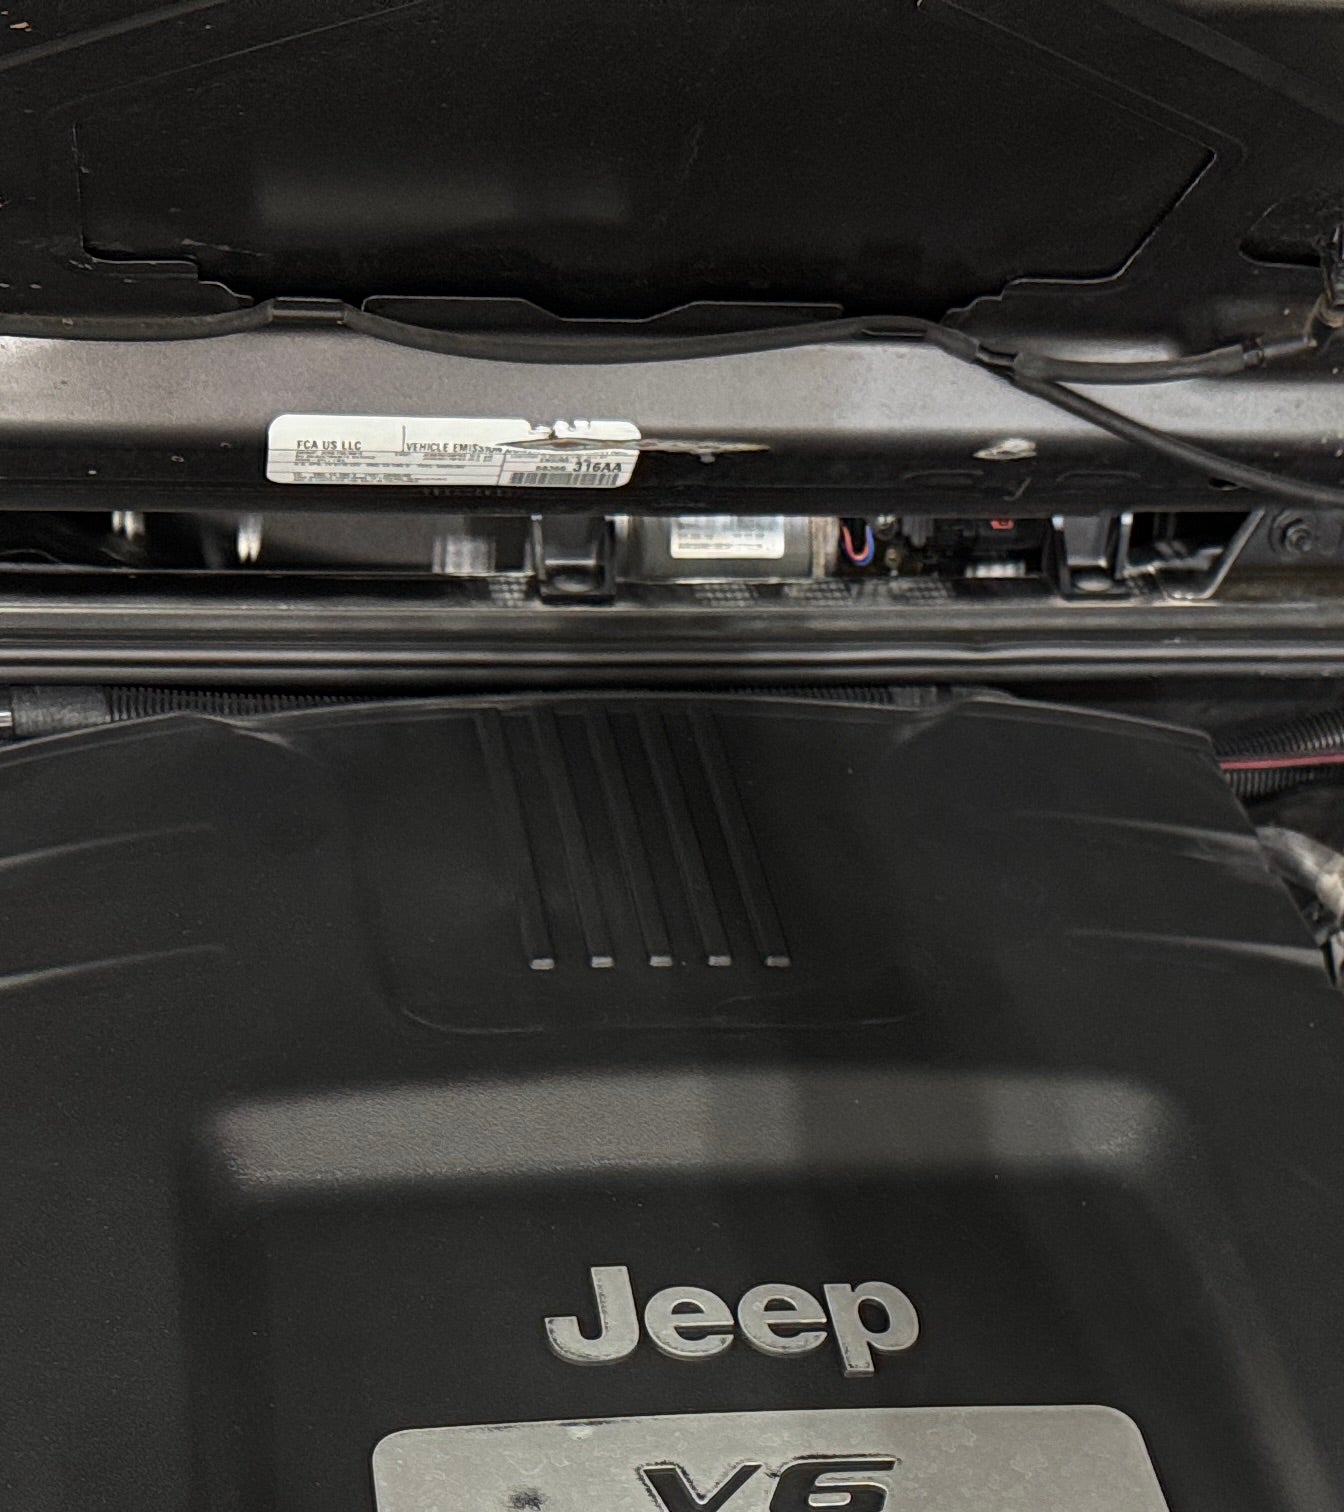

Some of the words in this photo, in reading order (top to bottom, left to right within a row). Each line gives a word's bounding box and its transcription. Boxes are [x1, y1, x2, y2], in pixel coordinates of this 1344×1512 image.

[296, 440, 319, 450] FCA
[322, 440, 338, 450] US
[341, 441, 362, 451] LLC
[406, 442, 449, 453] VEHICLE
[544, 1265, 920, 1378] Jeep
